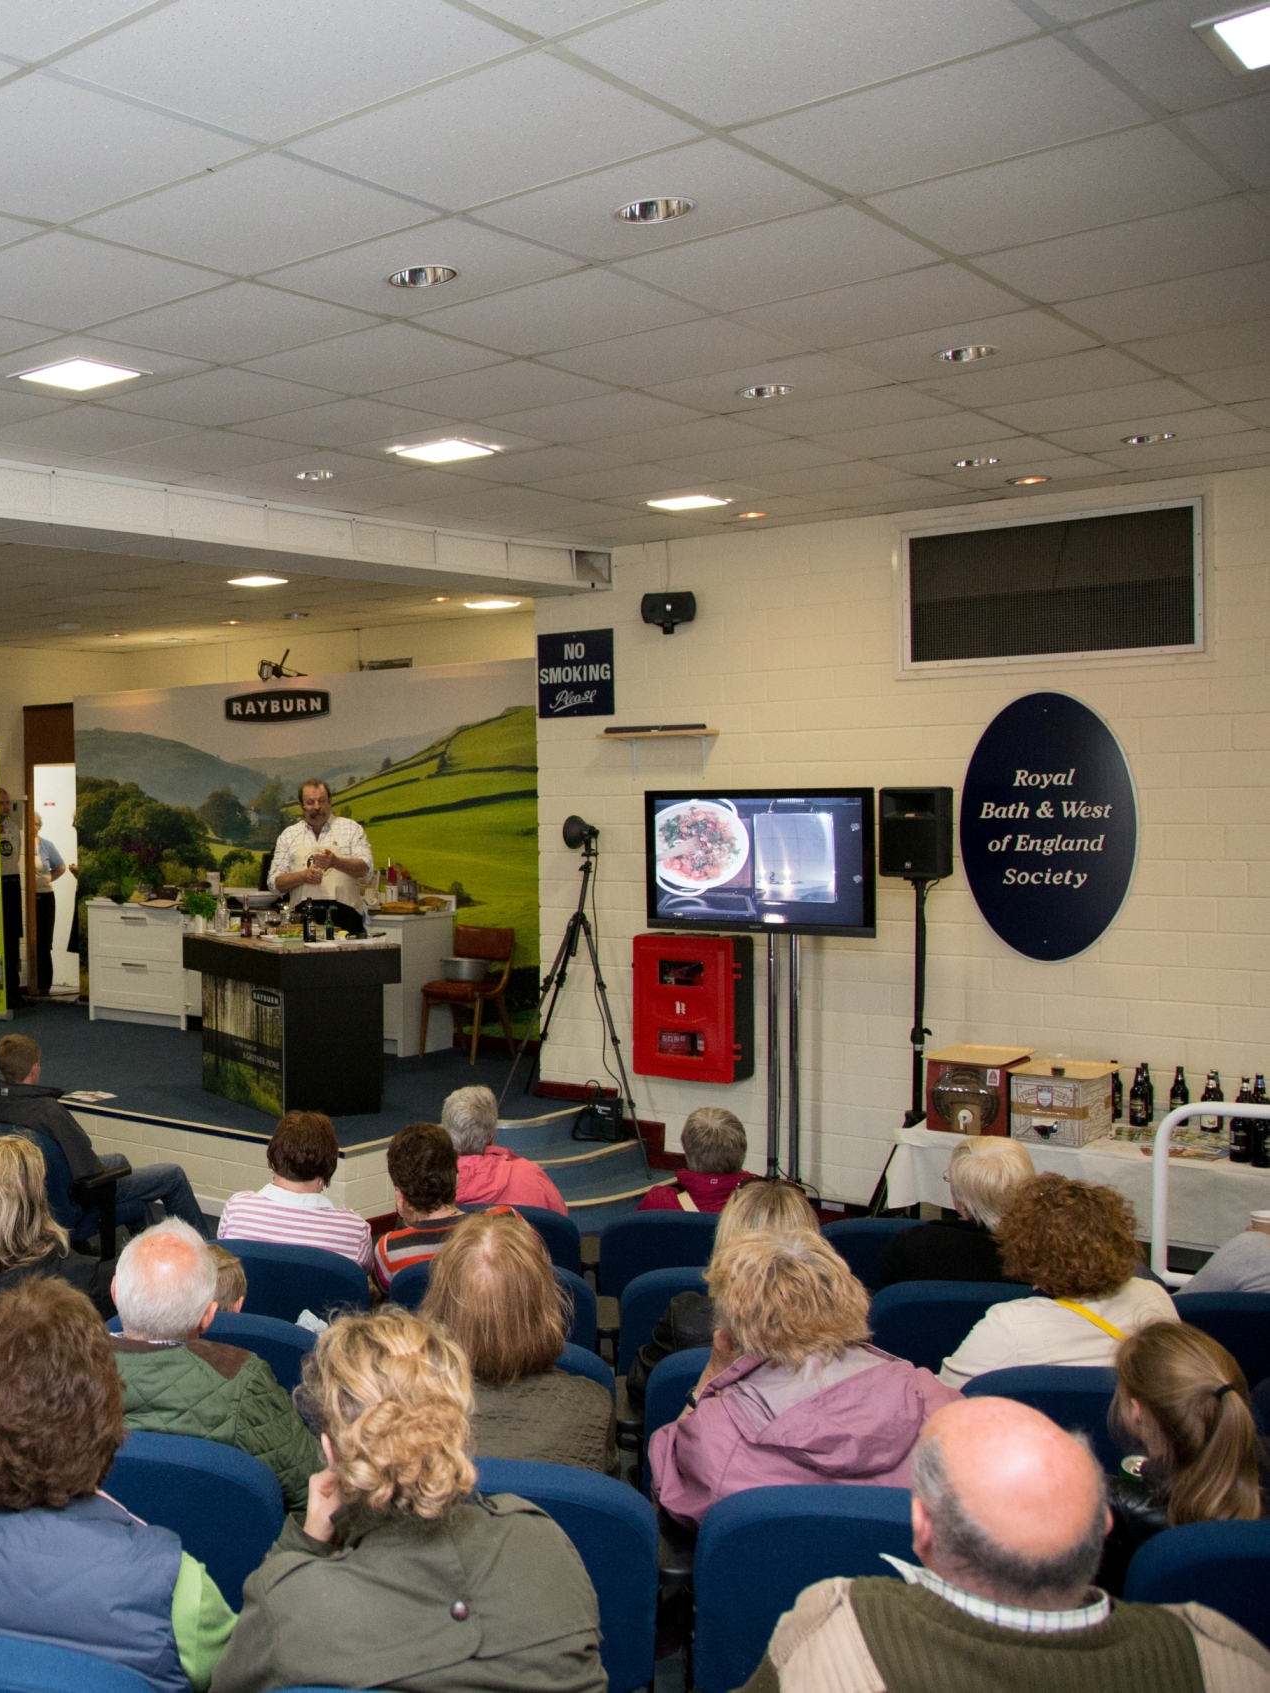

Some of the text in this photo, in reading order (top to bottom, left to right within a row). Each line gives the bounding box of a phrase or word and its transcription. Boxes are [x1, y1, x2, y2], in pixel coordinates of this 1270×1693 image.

[564, 642, 585, 660] NO
[540, 664, 610, 684] SMOKING
[232, 698, 322, 716] RAYBURN
[549, 690, 597, 712] Please
[1013, 768, 1076, 789] Royal
[980, 800, 1112, 819] Bath & West
[988, 834, 1105, 856] of England
[1002, 868, 1088, 888] Society
[253, 992, 279, 1005] RAYBURN
